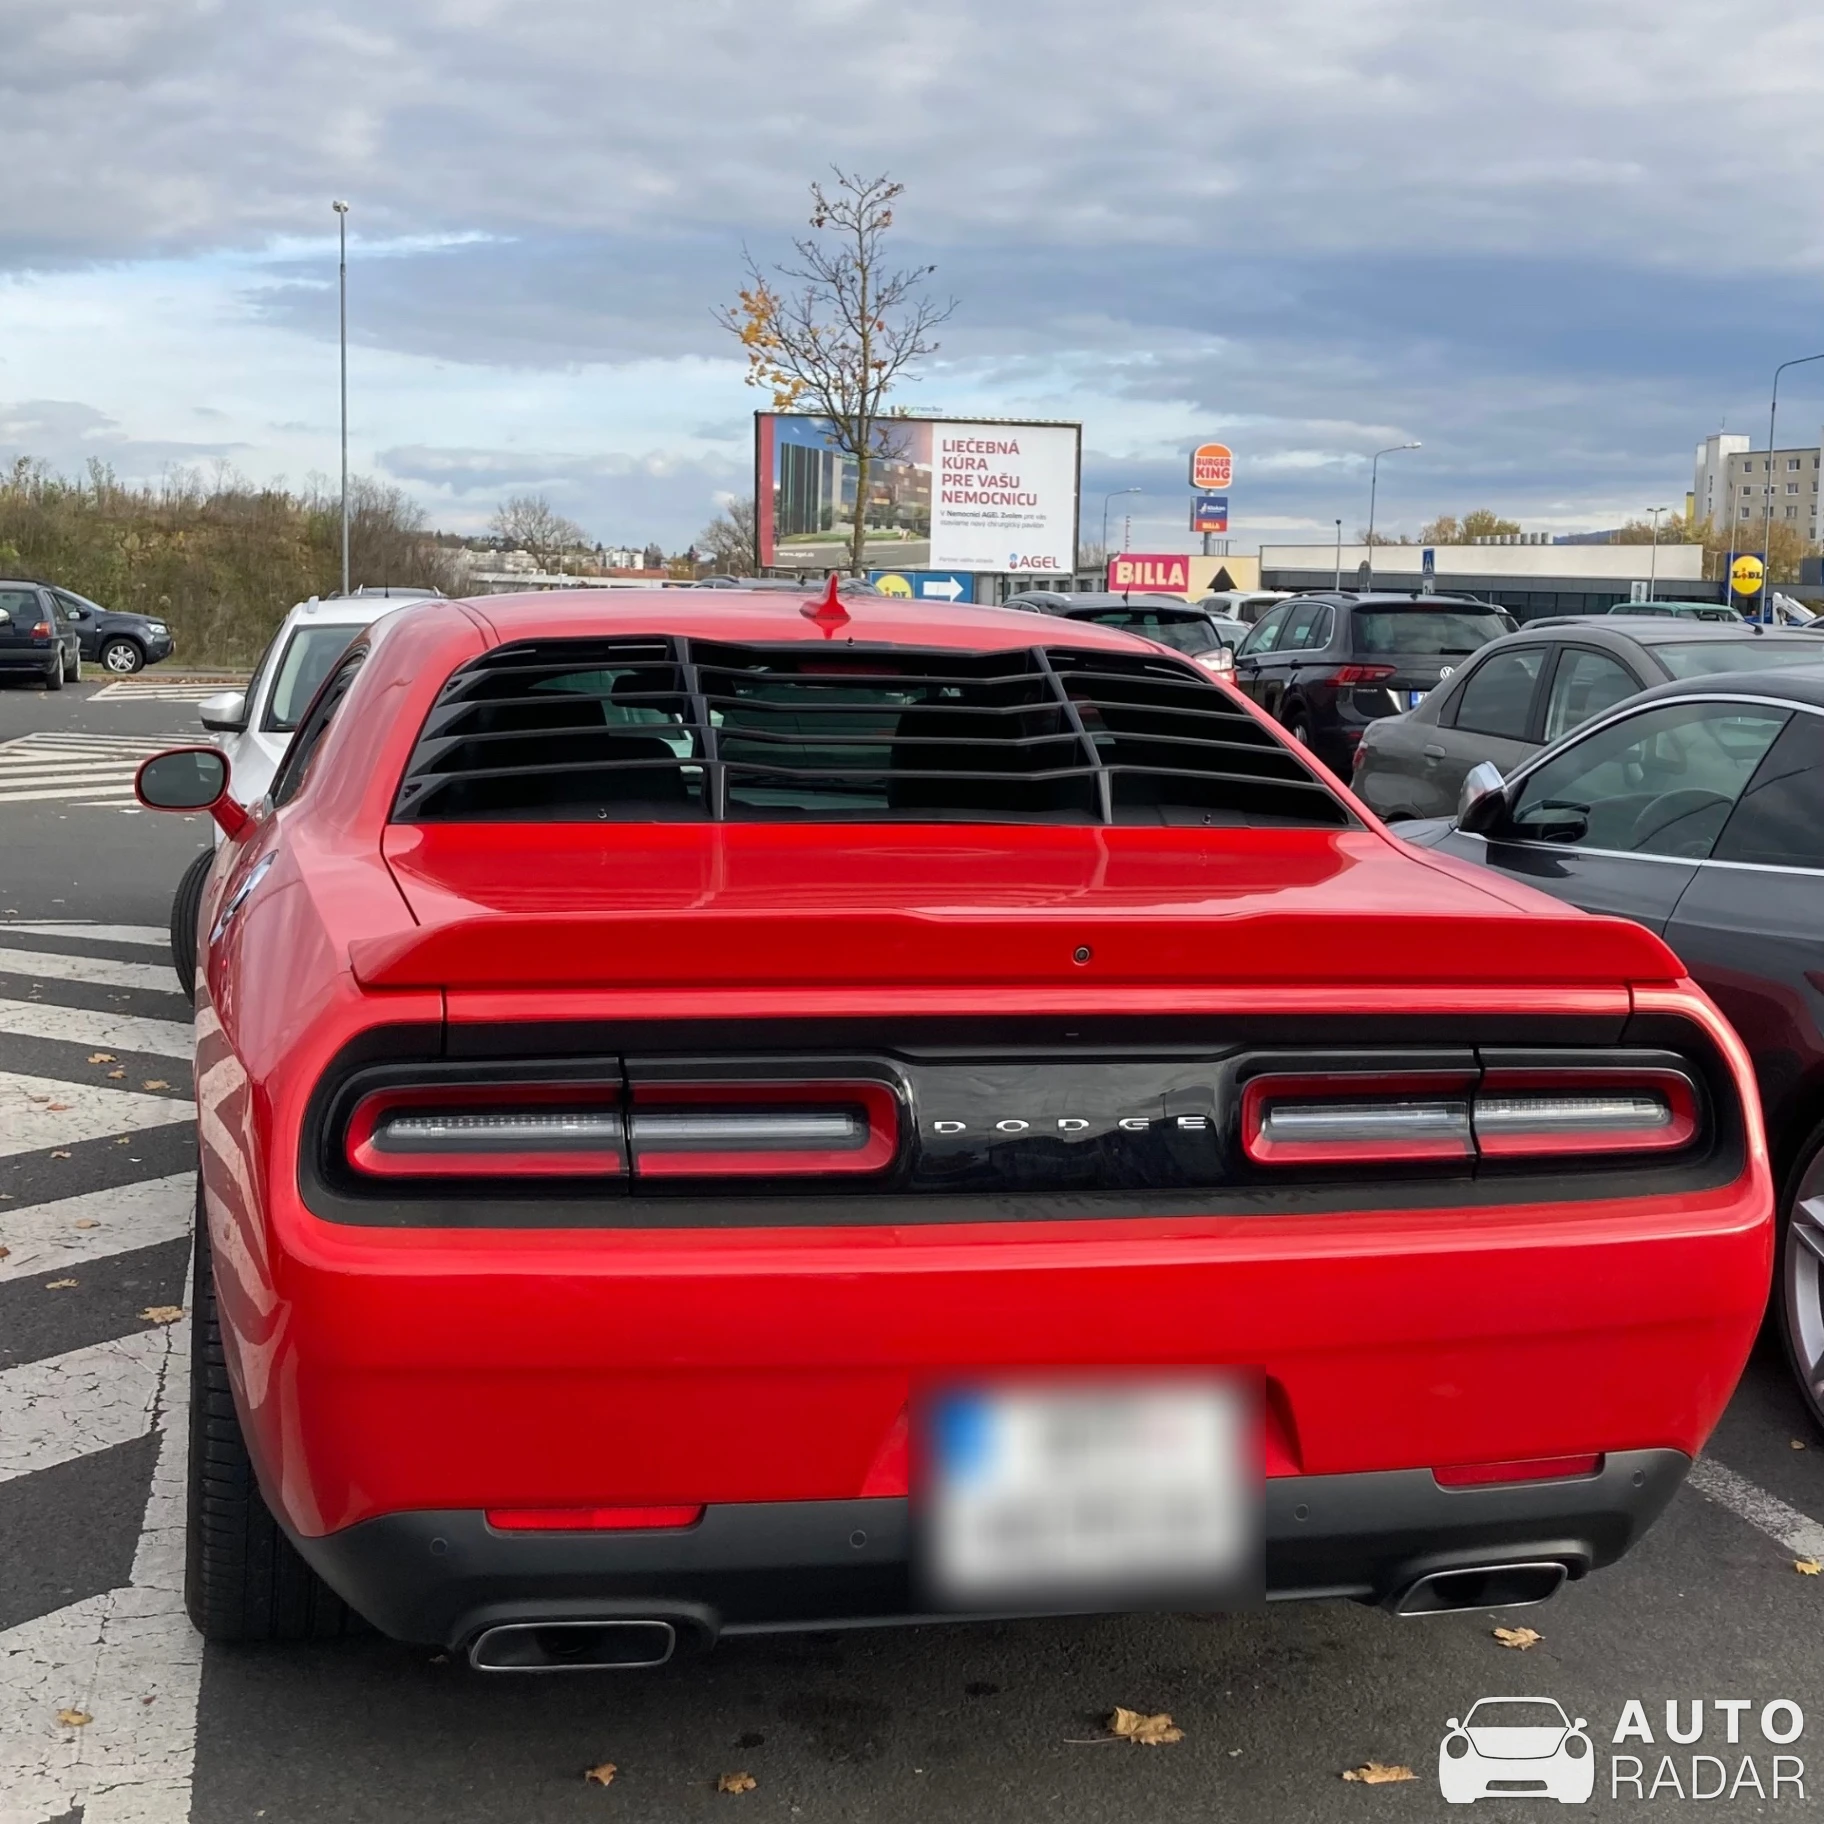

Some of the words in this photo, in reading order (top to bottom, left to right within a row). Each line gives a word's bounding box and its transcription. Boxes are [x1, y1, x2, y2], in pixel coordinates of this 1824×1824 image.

[942, 437, 1020, 455] LIEČEBNÁ
[942, 454, 988, 471] KÚRA
[1196, 457, 1231, 467] BURGER
[942, 473, 974, 487] PRE
[977, 472, 1020, 489] VAŠU
[1196, 466, 1231, 479] KING
[941, 490, 1037, 506] NEMOCNICU
[946, 510, 980, 518] Nemocnici
[981, 511, 999, 519] AGEL
[1019, 555, 1061, 569] AGEL
[1116, 561, 1185, 586] BILLA
[934, 1115, 1207, 1133] DODGE
